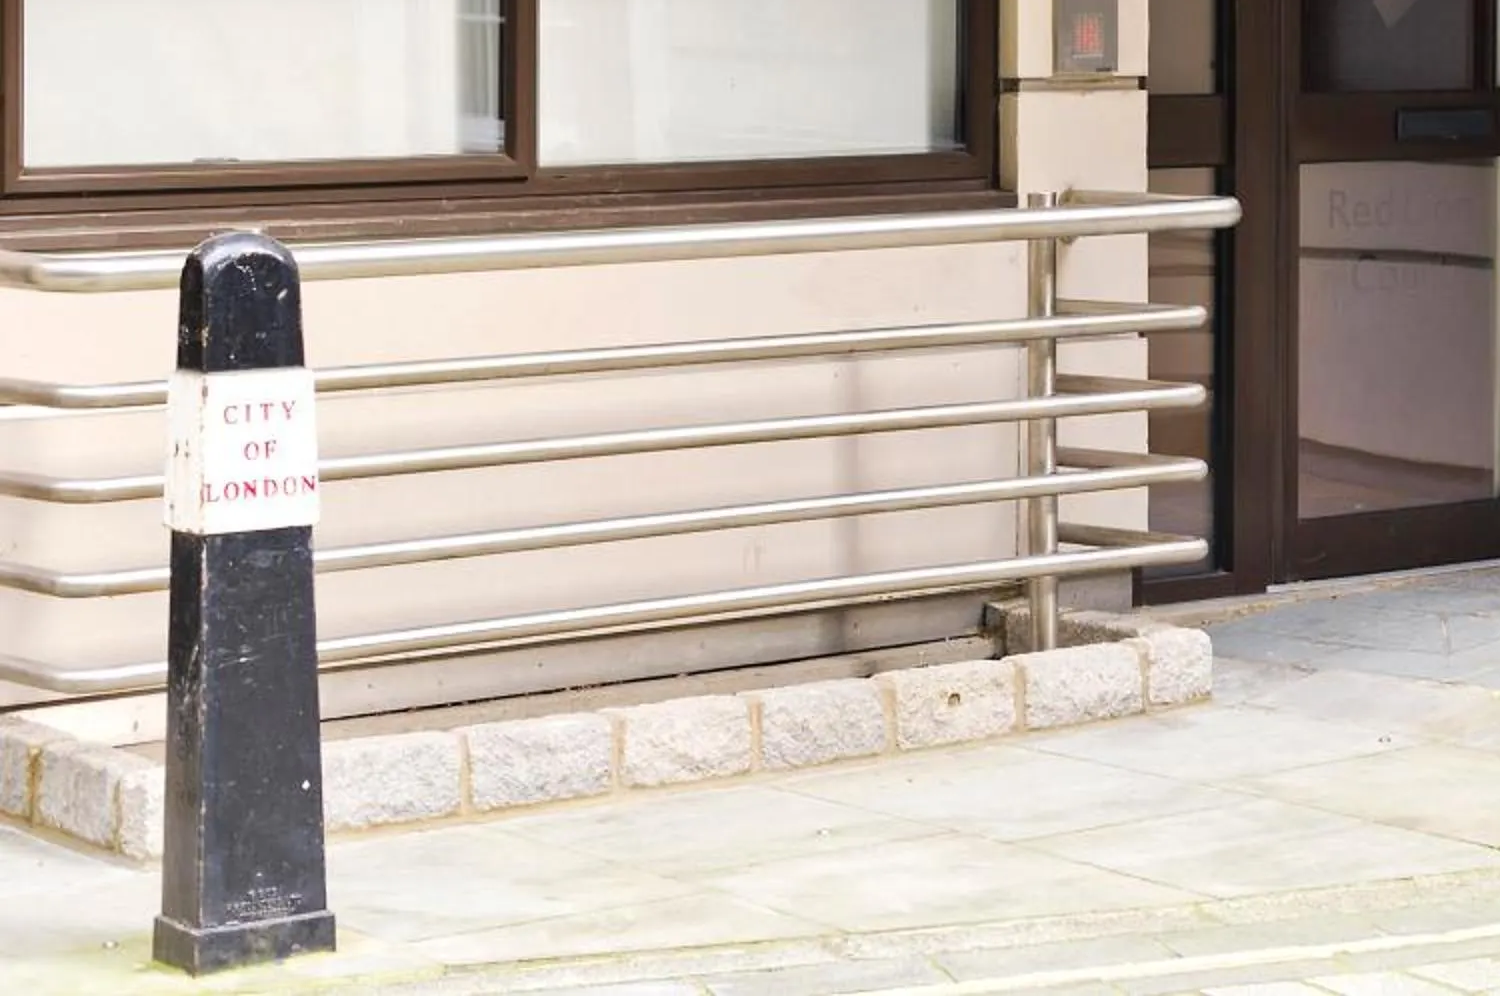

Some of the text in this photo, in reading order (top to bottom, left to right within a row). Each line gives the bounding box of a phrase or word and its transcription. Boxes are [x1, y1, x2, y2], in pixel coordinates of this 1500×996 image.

[1328, 187, 1394, 230] Red
[223, 399, 297, 425] CITY
[243, 439, 277, 461] OF
[204, 474, 317, 503] LONDON
